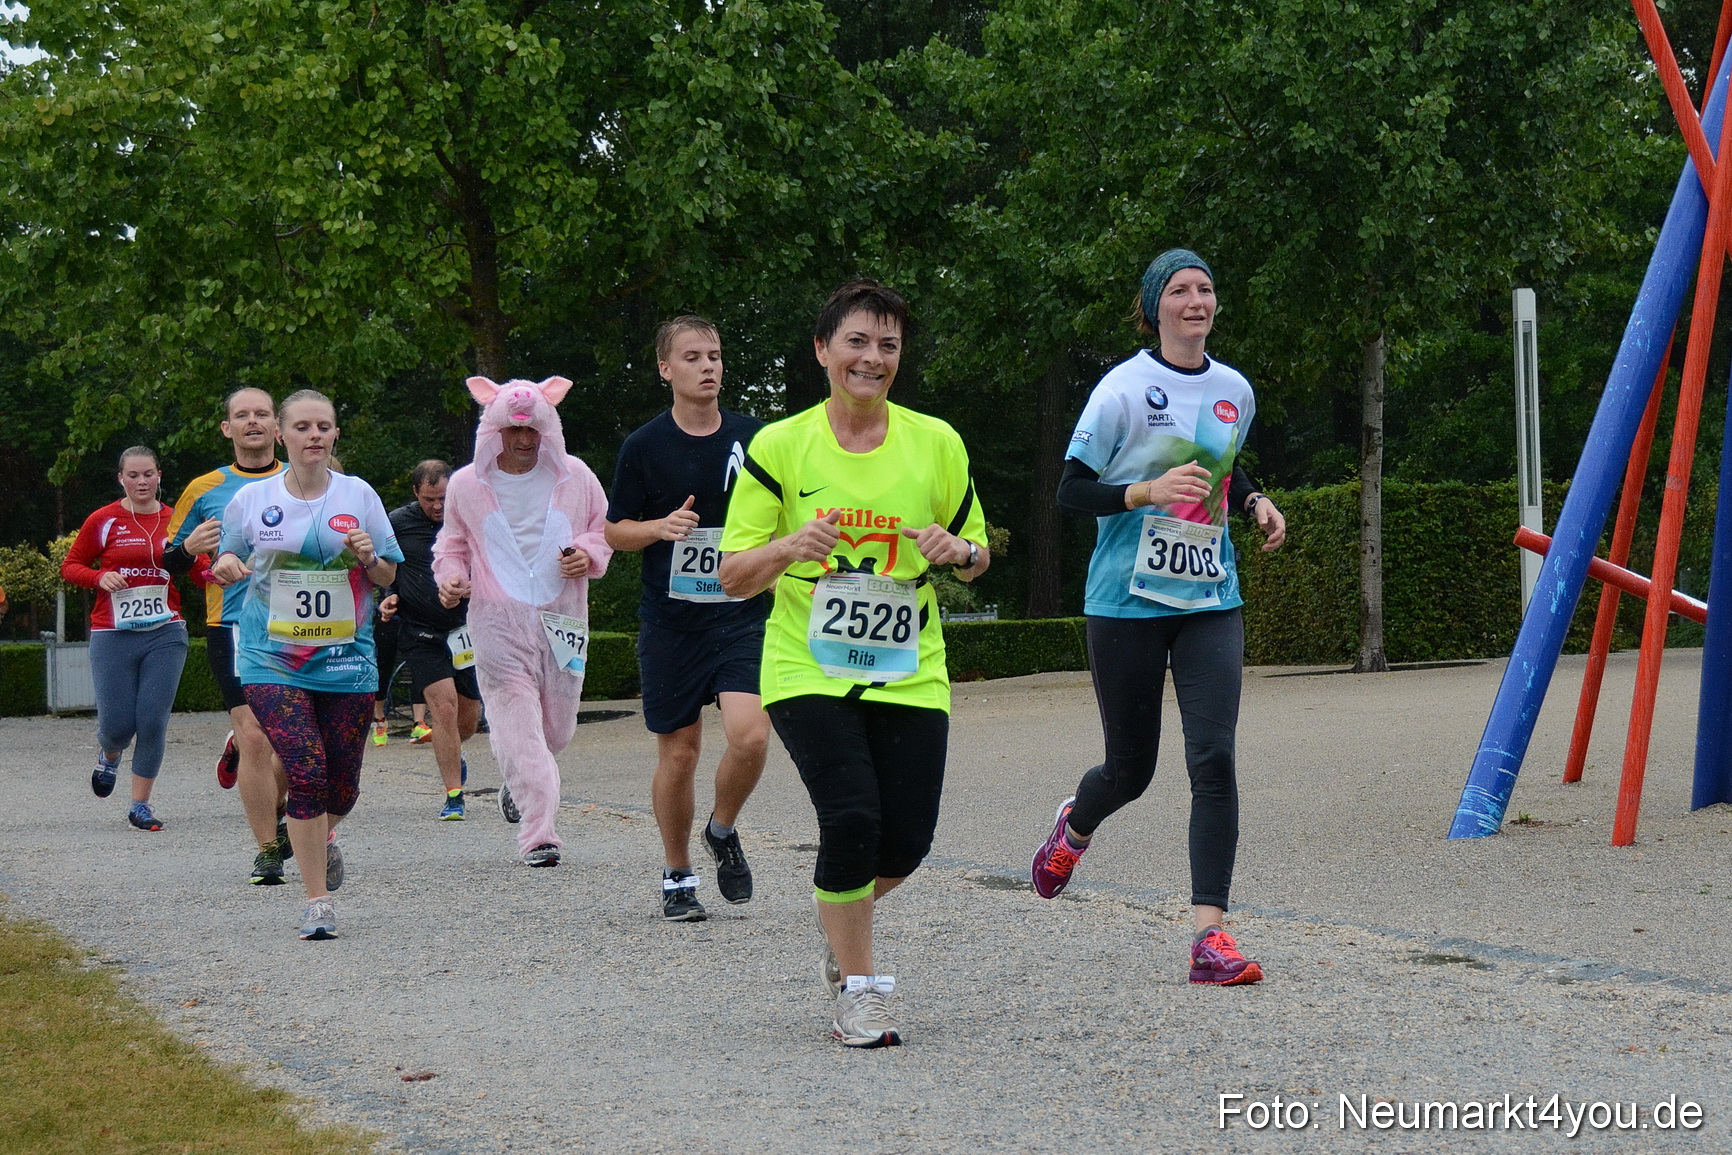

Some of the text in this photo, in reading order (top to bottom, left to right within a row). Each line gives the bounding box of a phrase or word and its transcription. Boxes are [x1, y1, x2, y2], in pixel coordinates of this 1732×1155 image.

[1148, 414, 1175, 422] PARTL
[333, 519, 357, 529] Hervis
[815, 507, 902, 530] Müller
[1151, 524, 1182, 535] NeuerMarkt
[1186, 526, 1218, 539] BOCK
[681, 546, 723, 574] 26
[1147, 537, 1219, 577] 3008
[307, 574, 347, 584] BOCK
[695, 581, 724, 593] Stefa
[825, 583, 861, 592] NeuerMarkt
[120, 597, 164, 619] 2256
[295, 590, 331, 619] 30
[822, 597, 912, 643] 2528
[292, 625, 332, 637] Sandra
[847, 649, 875, 666] Rita
[326, 664, 361, 672] Stadtlauf
